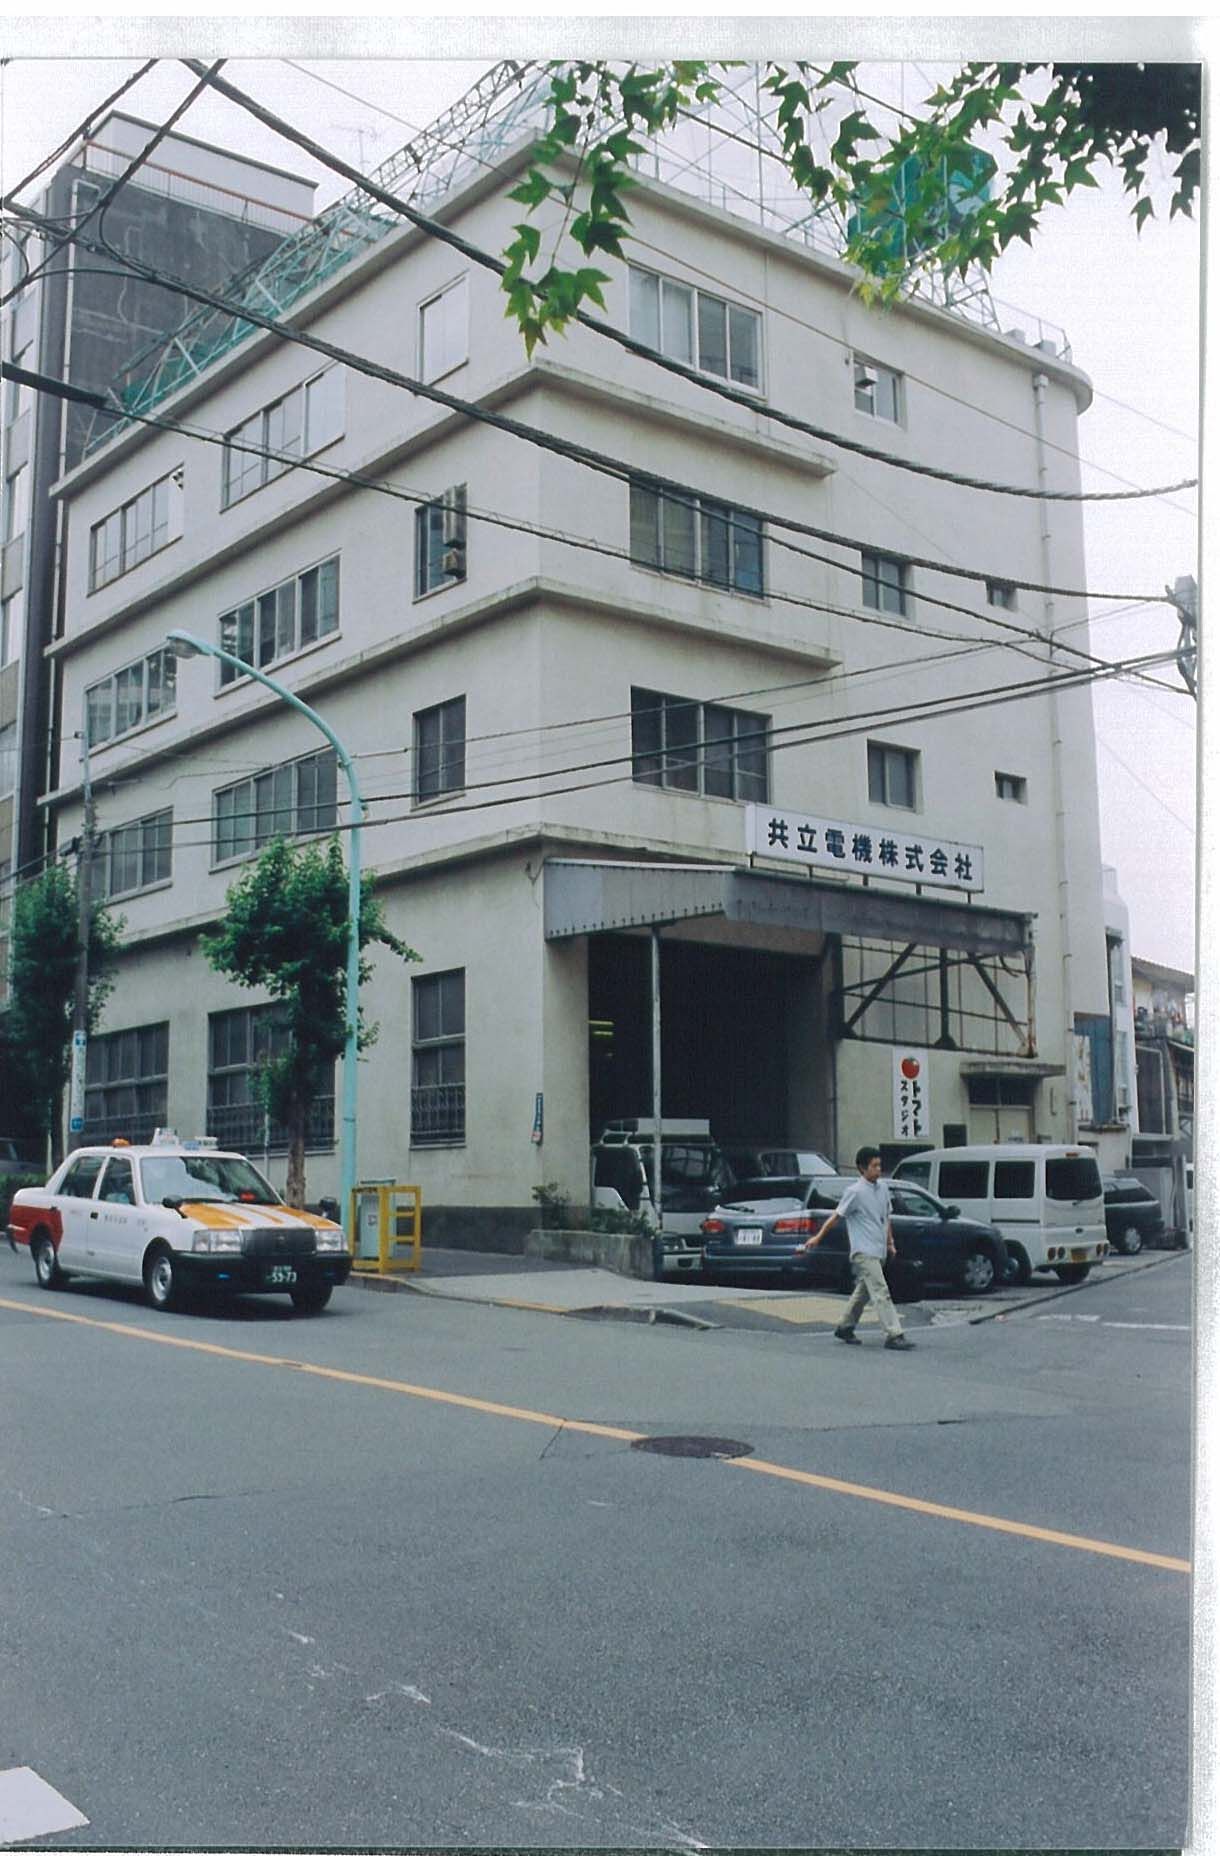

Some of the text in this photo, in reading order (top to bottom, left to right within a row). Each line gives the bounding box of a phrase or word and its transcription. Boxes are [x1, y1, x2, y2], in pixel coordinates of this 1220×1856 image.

[768, 818, 972, 881] 共立電機株式会社
[900, 1080, 909, 1137] スタジオ
[911, 1080, 922, 1137] トマト
